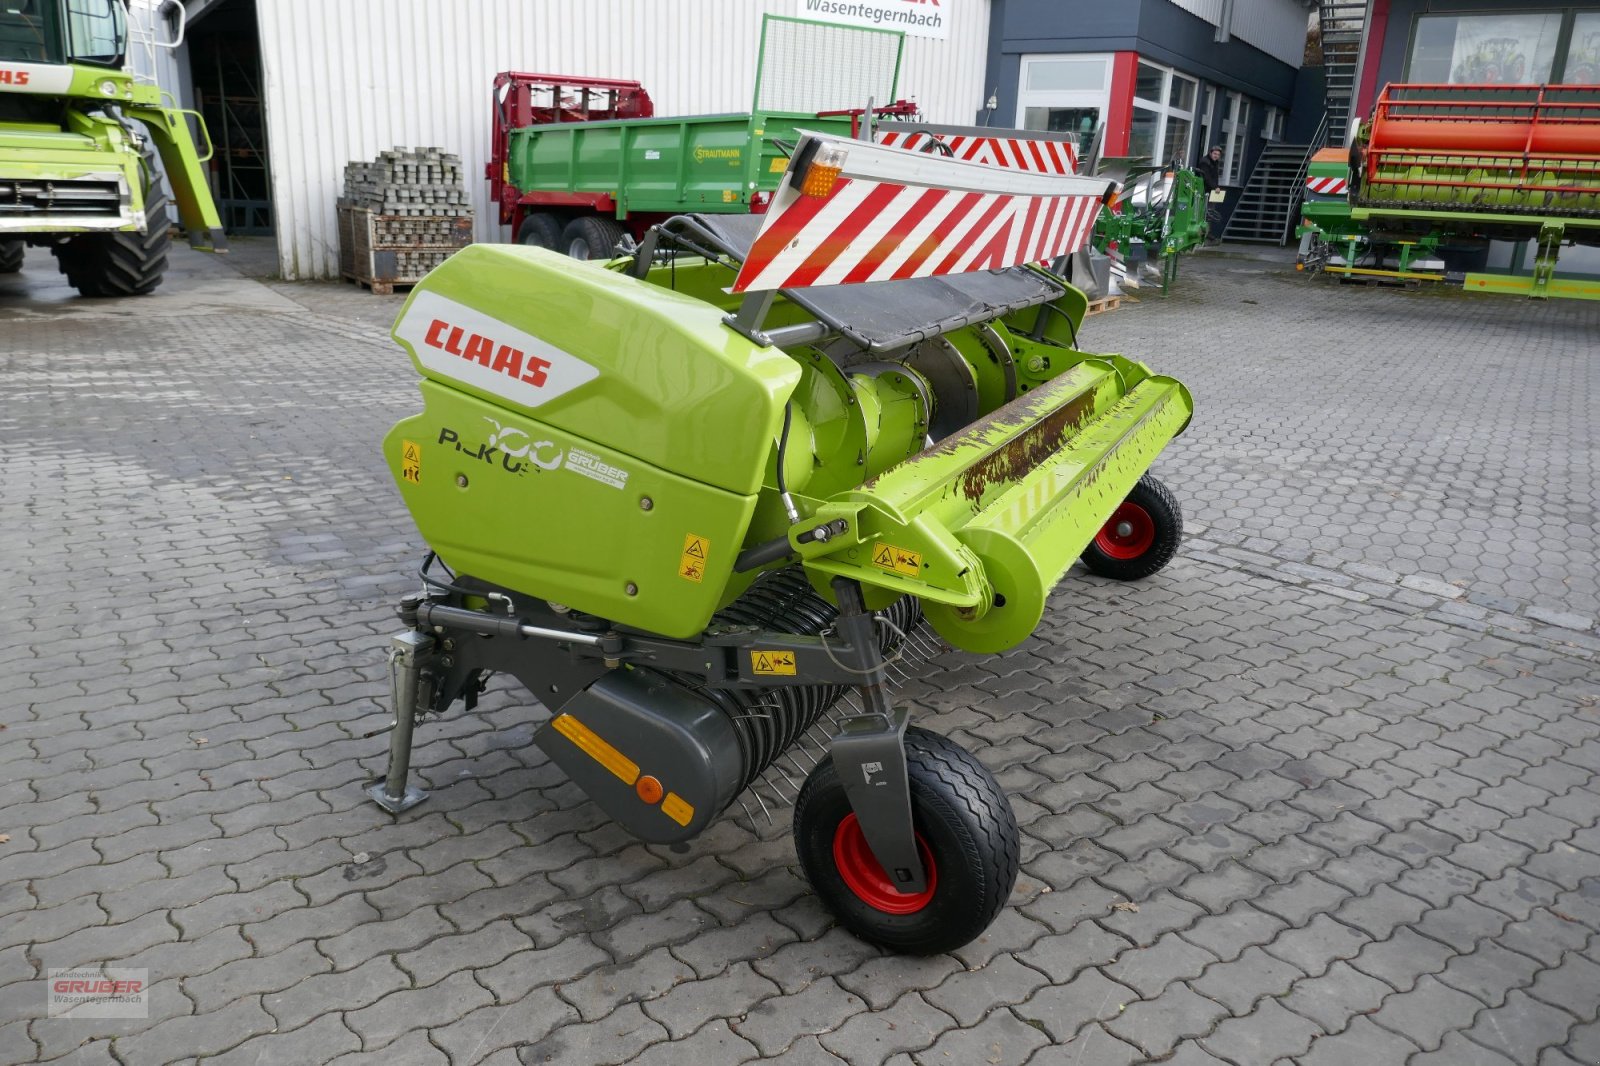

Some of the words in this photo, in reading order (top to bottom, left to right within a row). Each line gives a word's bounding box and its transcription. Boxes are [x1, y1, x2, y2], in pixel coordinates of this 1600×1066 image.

[806, 0, 942, 28] Wasentegernbach
[697, 149, 740, 159] STRAUTMANN
[424, 319, 552, 388] CLAAS
[568, 452, 629, 482] GRUBER
